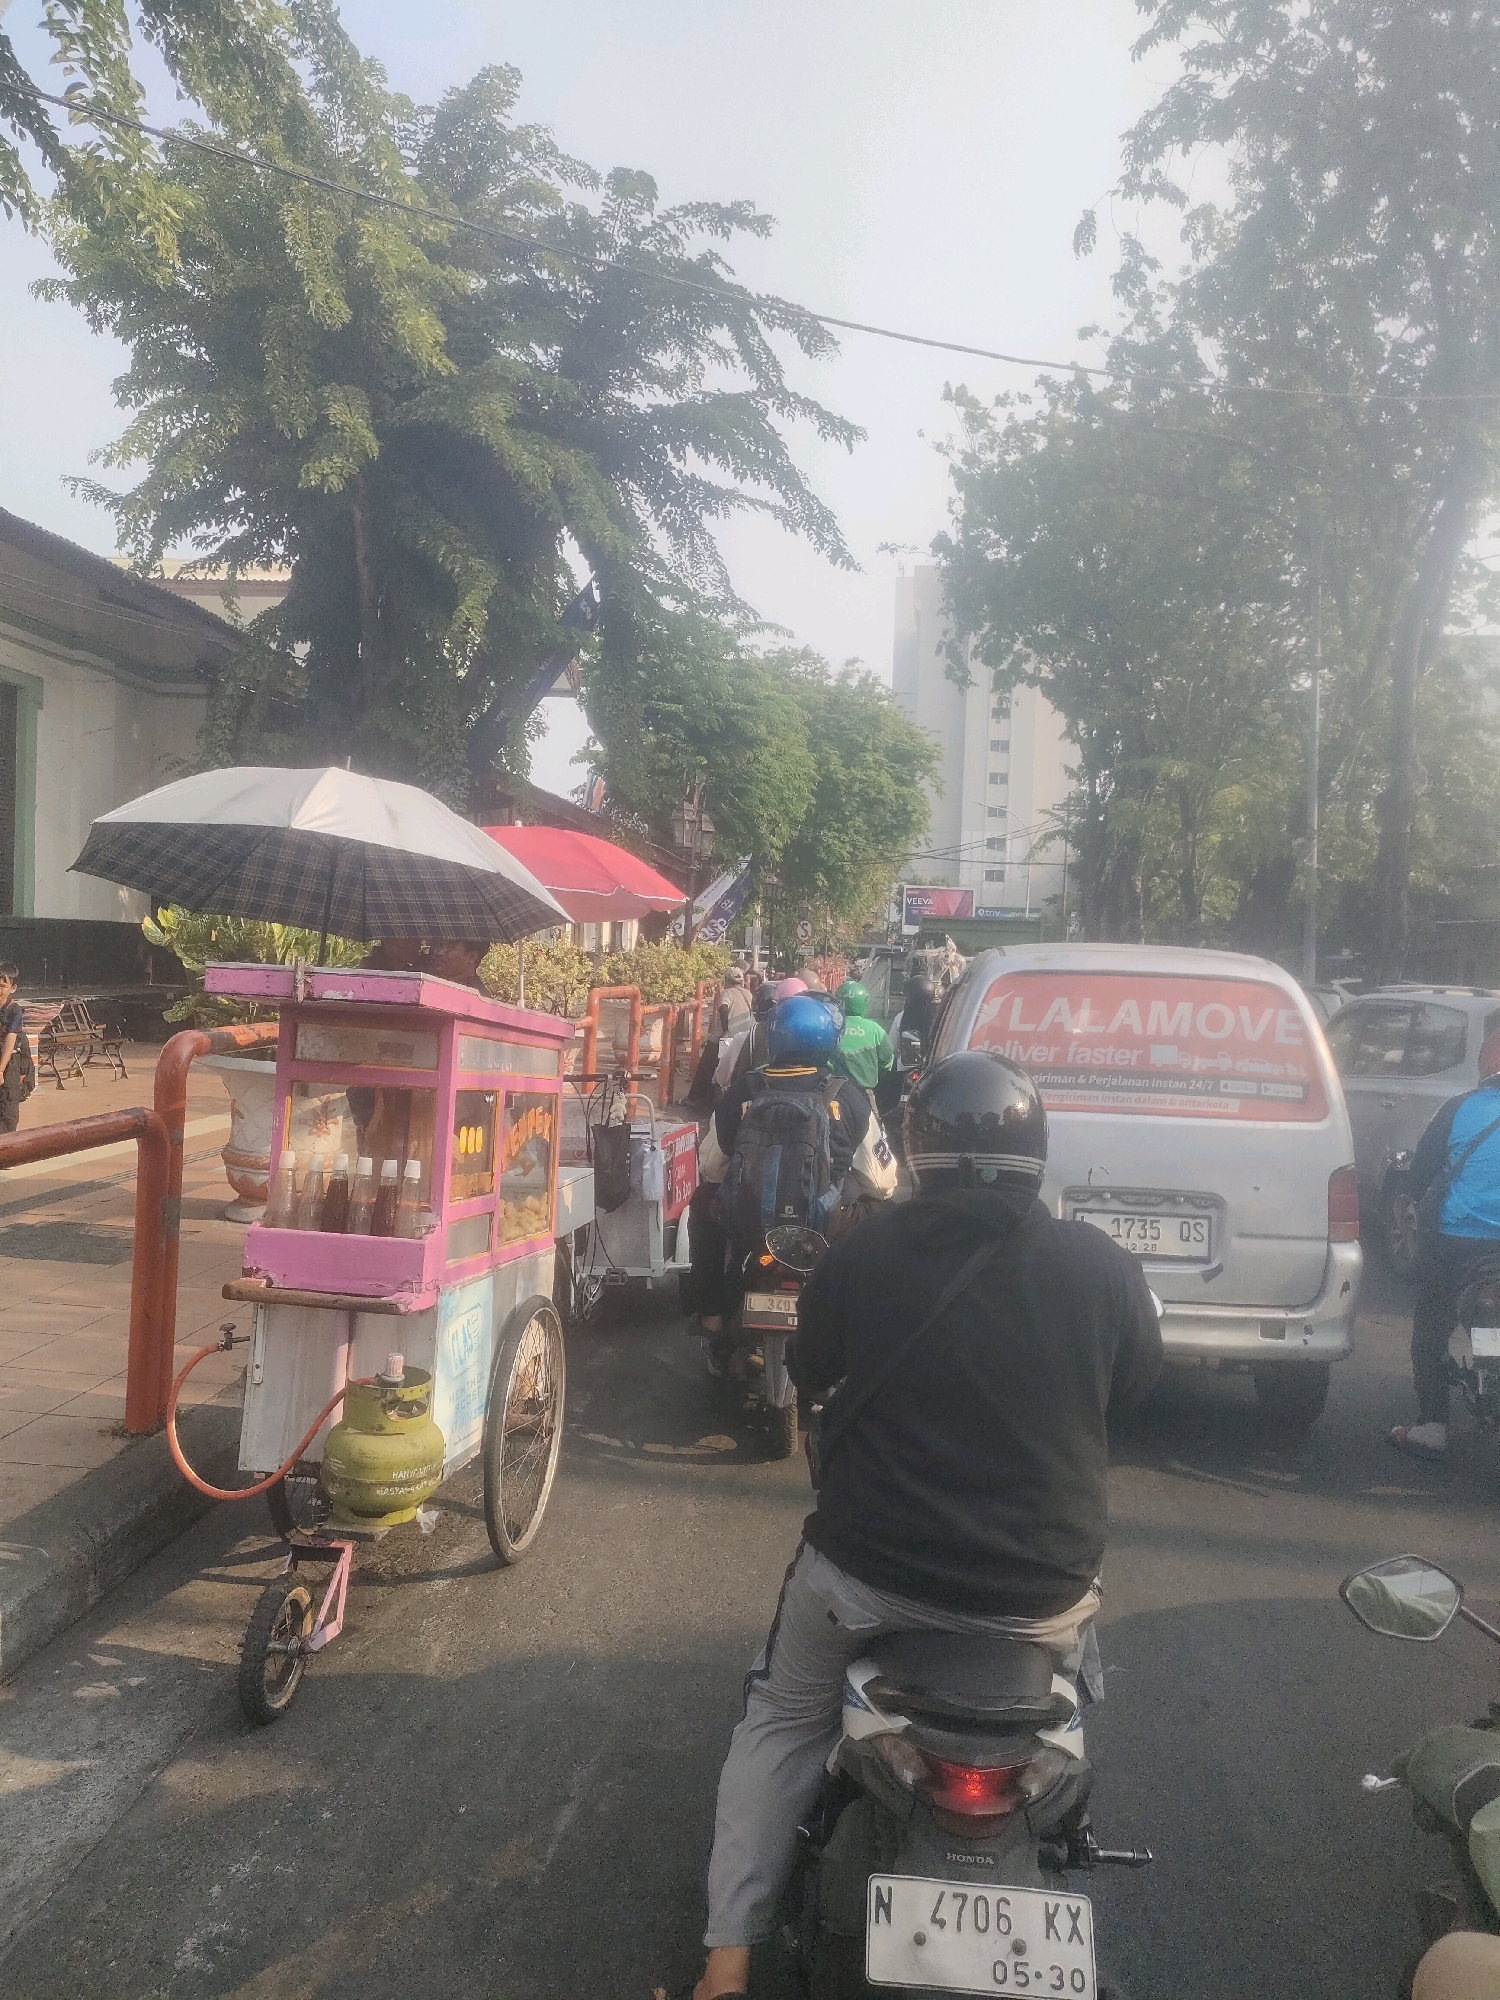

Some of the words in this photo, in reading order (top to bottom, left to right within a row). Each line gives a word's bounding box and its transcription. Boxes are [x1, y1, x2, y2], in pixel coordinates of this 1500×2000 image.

[906, 897, 934, 905] VEEVA
[844, 1025, 866, 1037] rab
[1008, 995, 1304, 1046] LALAMOVE
[971, 1039, 1060, 1063] deliver
[1066, 1041, 1143, 1066] faster
[1033, 1072, 1075, 1085] giriman
[1089, 1074, 1149, 1088] Perjalanan
[1151, 1078, 1187, 1089] Instan
[1188, 1080, 1213, 1092] 24/7
[1041, 1092, 1100, 1104] Pengiriman
[1101, 1092, 1132, 1104] instan
[1135, 1096, 1167, 1106] dalam
[1178, 1098, 1229, 1110] antarkota
[1111, 1217, 1161, 1241] 1735
[1179, 1220, 1205, 1243] QS
[767, 1297, 796, 1312] 340
[448, 1369, 485, 1405] MENTHOL
[454, 1385, 482, 1415] BOOST
[946, 1852, 995, 1865] HONDA
[874, 1884, 893, 1926] N
[930, 1890, 1012, 1936] 4706
[1044, 1901, 1085, 1946] KX
